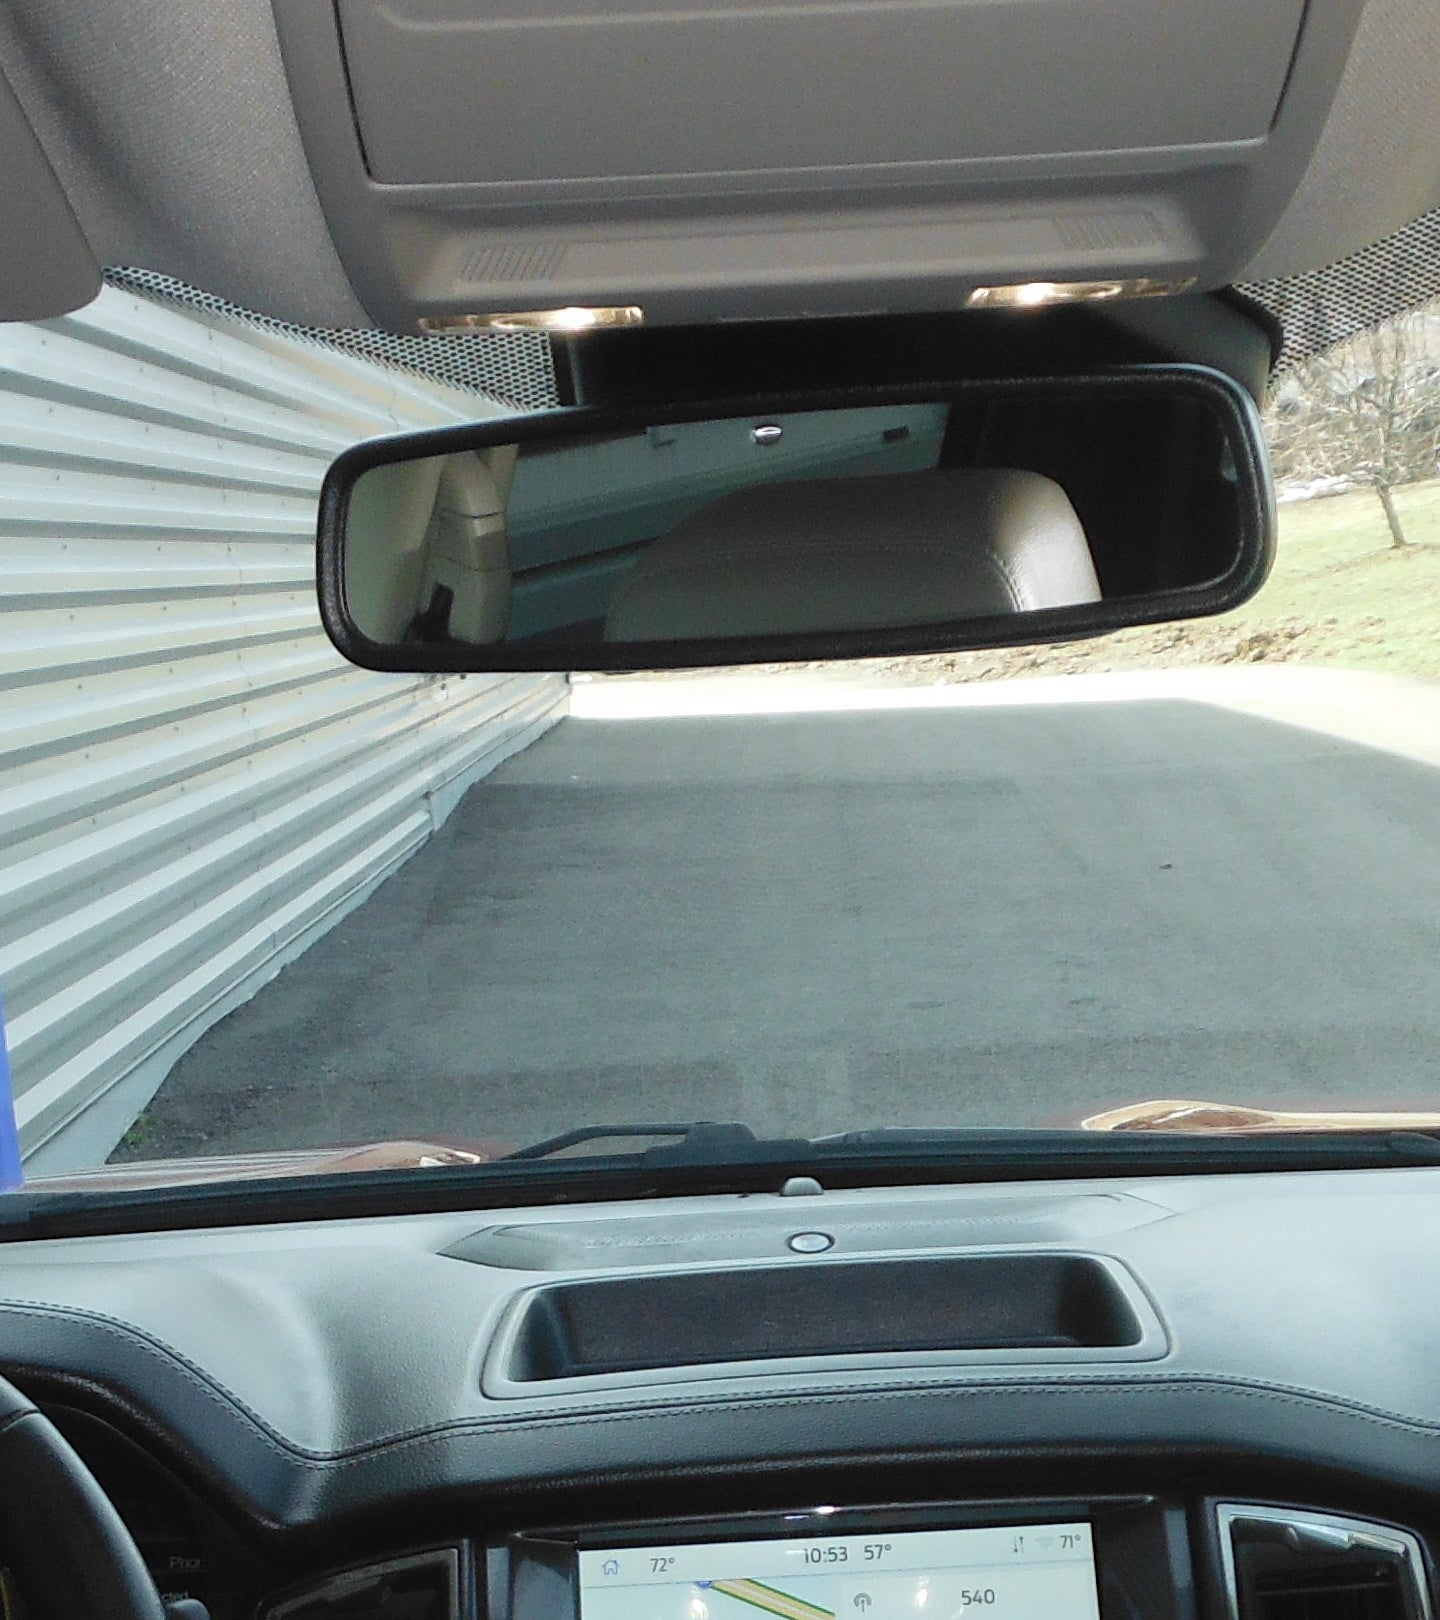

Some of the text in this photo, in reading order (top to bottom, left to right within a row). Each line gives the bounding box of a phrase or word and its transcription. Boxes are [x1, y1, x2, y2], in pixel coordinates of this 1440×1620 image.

[1060, 1534, 1081, 1549] 71°
[803, 1546, 849, 1564] 10:53
[864, 1543, 892, 1560] 57°
[650, 1557, 676, 1573] 72°
[961, 1588, 995, 1605] 540
